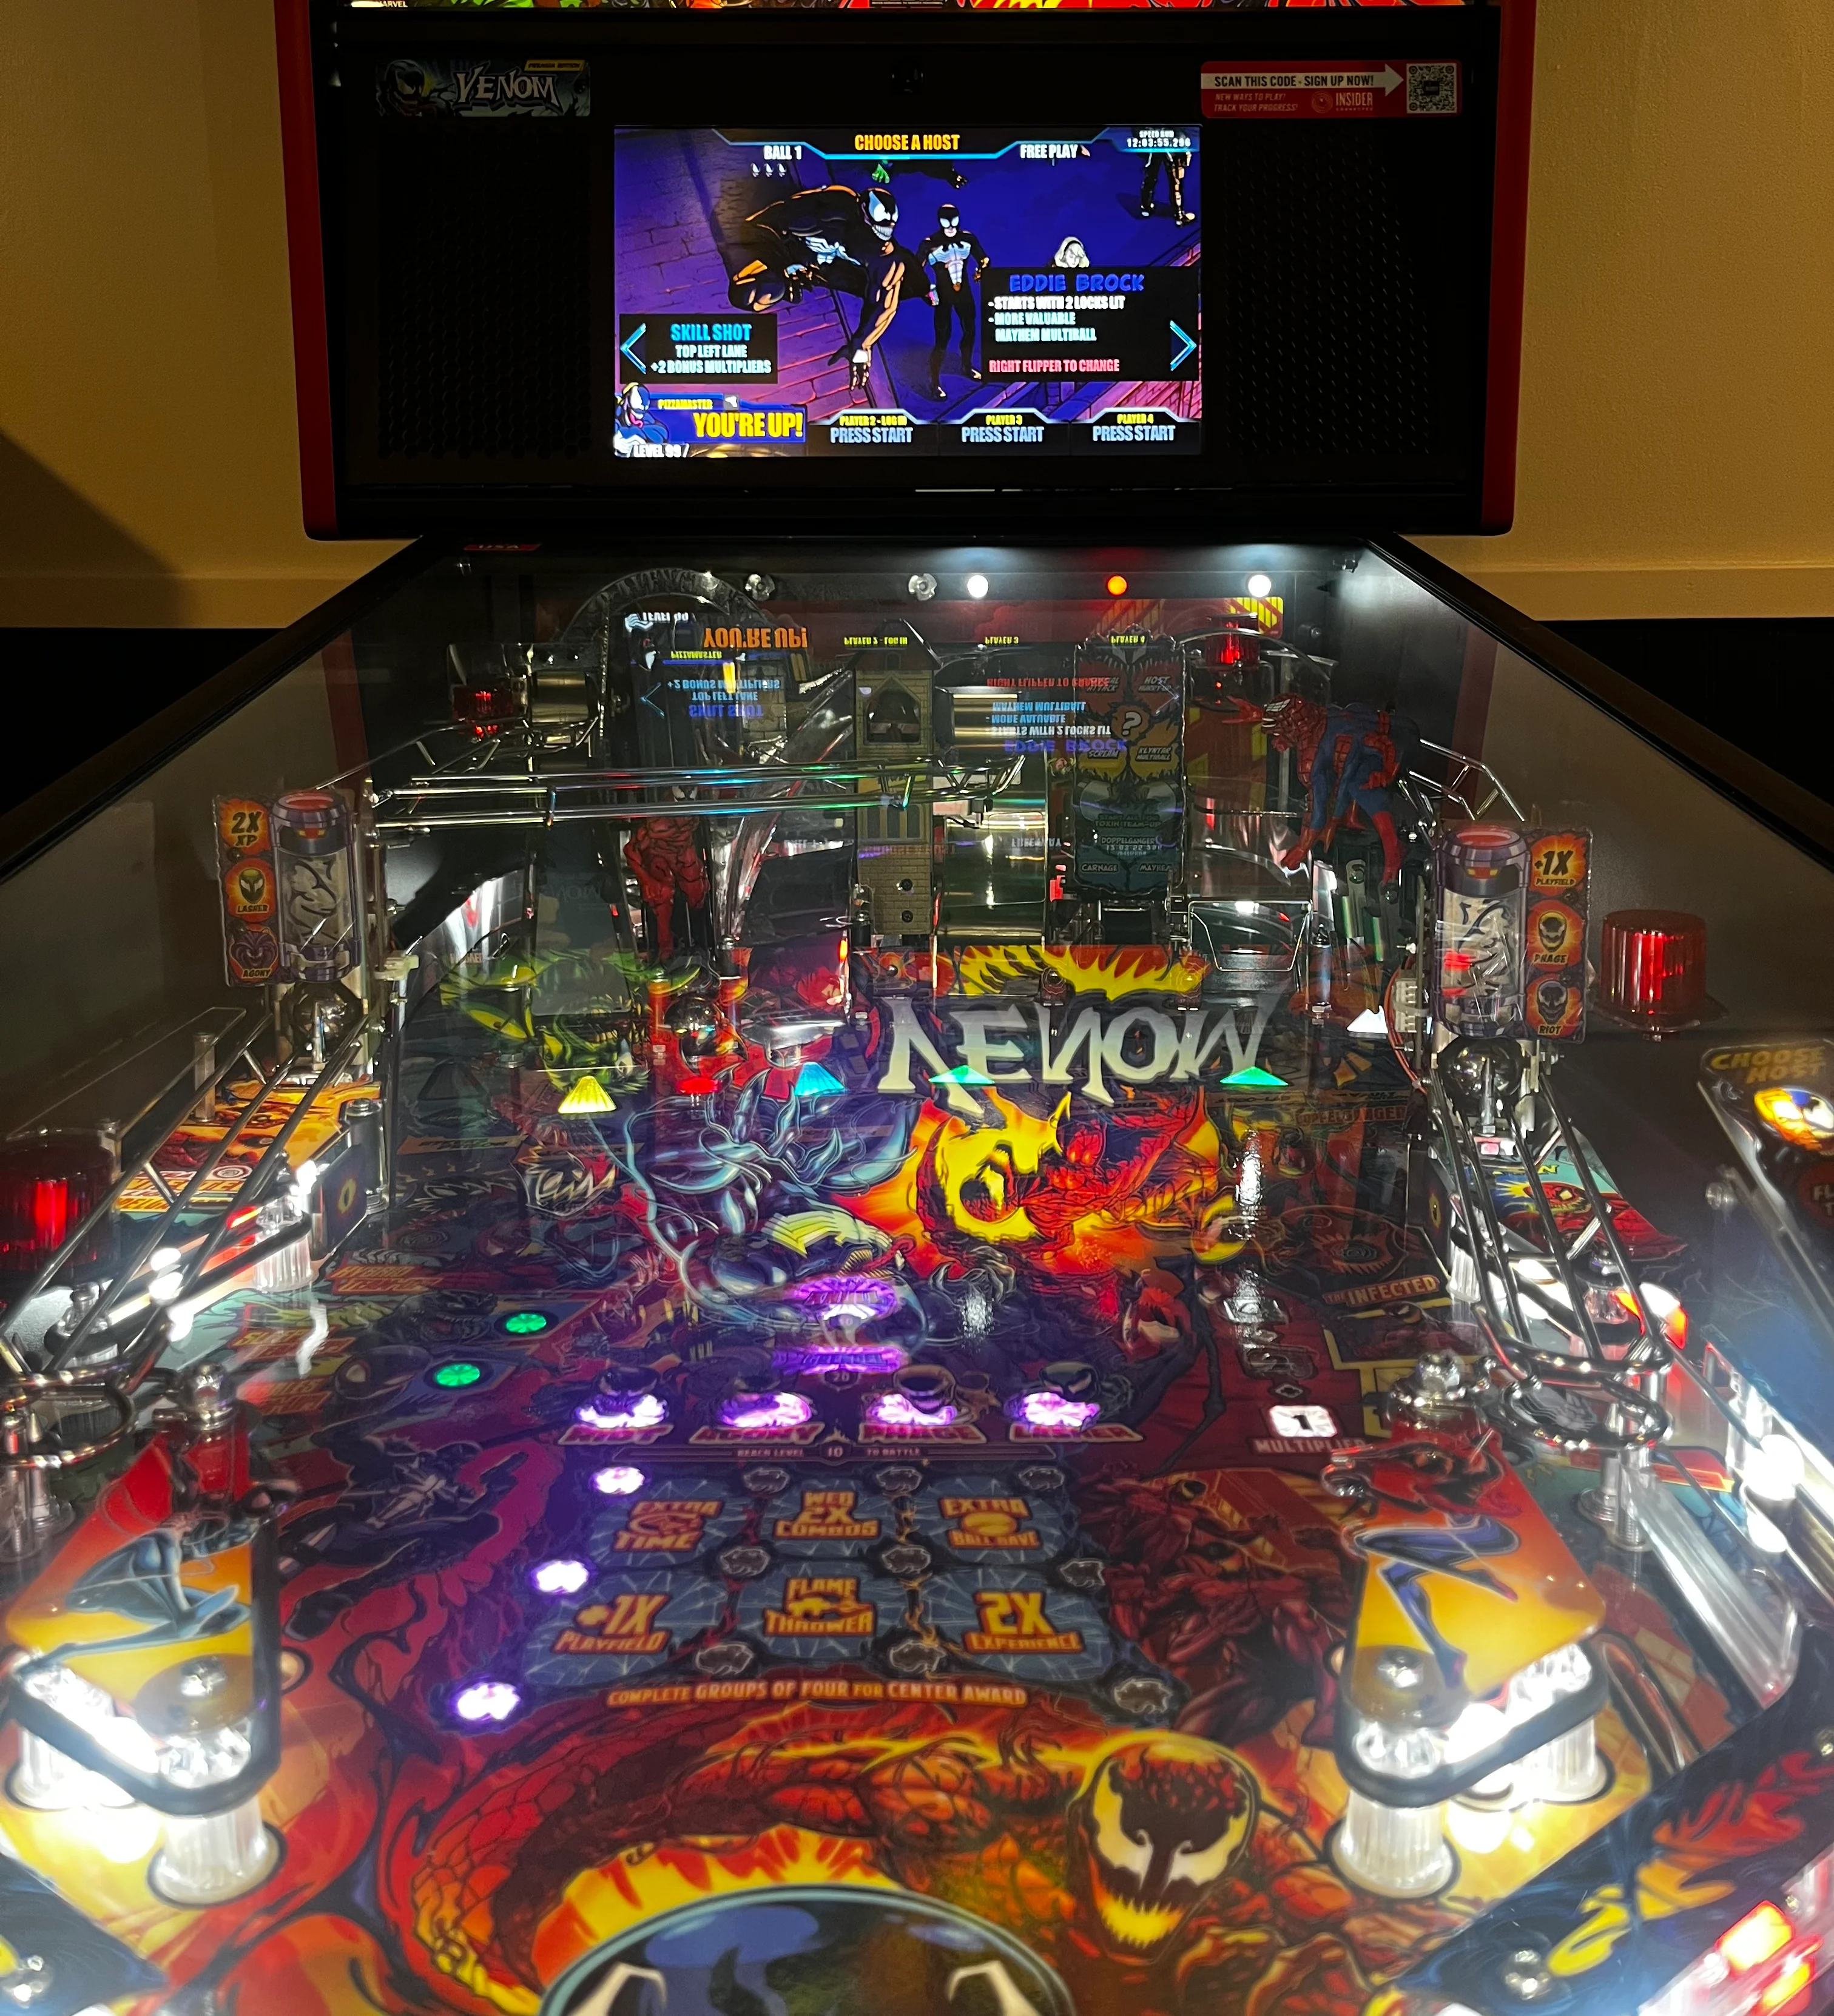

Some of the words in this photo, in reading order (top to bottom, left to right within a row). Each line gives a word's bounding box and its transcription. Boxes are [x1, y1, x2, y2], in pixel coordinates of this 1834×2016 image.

[455, 66, 559, 106] VENOM
[1215, 76, 1242, 87] SCAN
[1245, 76, 1267, 87] THIS
[1270, 76, 1296, 87] CODE
[1304, 75, 1327, 87] SIGN
[1330, 75, 1344, 86] UP
[1347, 75, 1374, 86] NOW!
[1335, 92, 1374, 106] INSIDER
[1214, 103, 1237, 112] TRACK
[1239, 103, 1257, 112] YOUR
[1258, 103, 1298, 112] PROGRESS!
[854, 134, 909, 150] CHOOSE
[911, 134, 921, 150] A
[923, 134, 960, 150] HOST
[764, 145, 792, 160] BALL
[795, 145, 802, 160] 1
[1020, 144, 1048, 158] FREE
[1048, 144, 1078, 158] PLAY
[1009, 274, 1067, 292] EDDIE
[1076, 274, 1145, 292] BROCK
[994, 295, 1035, 309] STARTS
[1035, 295, 1065, 309] WITH
[1065, 295, 1074, 309] 2
[1074, 295, 1109, 309] LOCKS
[1109, 295, 1126, 309] LIT
[994, 312, 1025, 325] MORE
[1025, 312, 1076, 325] VALUABLE
[670, 323, 711, 341] SKILL
[712, 323, 752, 341] SHOT
[995, 328, 1040, 342] MAYHEM
[1040, 328, 1097, 342] MULTIBALL
[675, 345, 697, 359] TOP
[698, 345, 722, 359] LEFT
[722, 345, 747, 359] LANE
[650, 360, 667, 374] +2
[667, 360, 704, 374] BONUS
[704, 360, 772, 374] MULTIPLIERS
[989, 359, 1021, 373] RIGHT
[1023, 359, 1062, 373] FLIPPER
[1063, 359, 1077, 373] TO
[1079, 359, 1120, 373] CHANGE
[658, 399, 713, 410] PIZZAMASTER
[693, 412, 766, 438] YOU'RE
[767, 412, 803, 437] UP!
[839, 416, 869, 426] PLAYER
[869, 416, 876, 426] 2
[882, 416, 897, 426] LOG
[897, 416, 908, 426] IN
[986, 414, 1016, 425] PLAYER
[1016, 414, 1023, 425] 3
[1117, 414, 1147, 424] PLAYER
[1147, 414, 1154, 423] 4
[830, 427, 871, 443] PRESS
[872, 427, 914, 443] START
[961, 426, 1002, 442] PRESS
[1003, 426, 1044, 442] START
[1093, 425, 1133, 441] PRESS
[1134, 425, 1176, 441] START
[633, 444, 664, 457] LEVEL
[1144, 676, 1171, 684] HOST
[1122, 711, 1142, 736] ?
[232, 811, 262, 834] 2X
[235, 834, 257, 846] XP
[1534, 954, 1566, 963] PHAGE
[1539, 1025, 1562, 1035] RIOT
[1711, 1047, 1824, 1070] CHOOSE
[1746, 1065, 1819, 1084] HOST
[1347, 1276, 1438, 1305] INFECTED
[1293, 1415, 1312, 1430] 1
[828, 1447, 843, 1457] 10
[797, 1507, 853, 1523] 2X
[943, 1499, 1029, 1517] EXTRA
[775, 1520, 880, 1537] COMBOS
[614, 1531, 704, 1551] TIME
[789, 1578, 858, 1598] FLAME
[976, 1591, 1054, 1634] 2X
[764, 1609, 874, 1633] THROWER
[553, 1630, 668, 1653] PLAYFIELD
[969, 1631, 1082, 1650] EXPERIENCE
[609, 1685, 691, 1705] COMPLETE
[696, 1681, 767, 1700] GROUPS
[770, 1680, 797, 1699] OF
[801, 1679, 849, 1697] FOUR
[853, 1683, 883, 1697] FOR
[888, 1681, 958, 1699] CENTER
[963, 1685, 1028, 1707] AWARD
